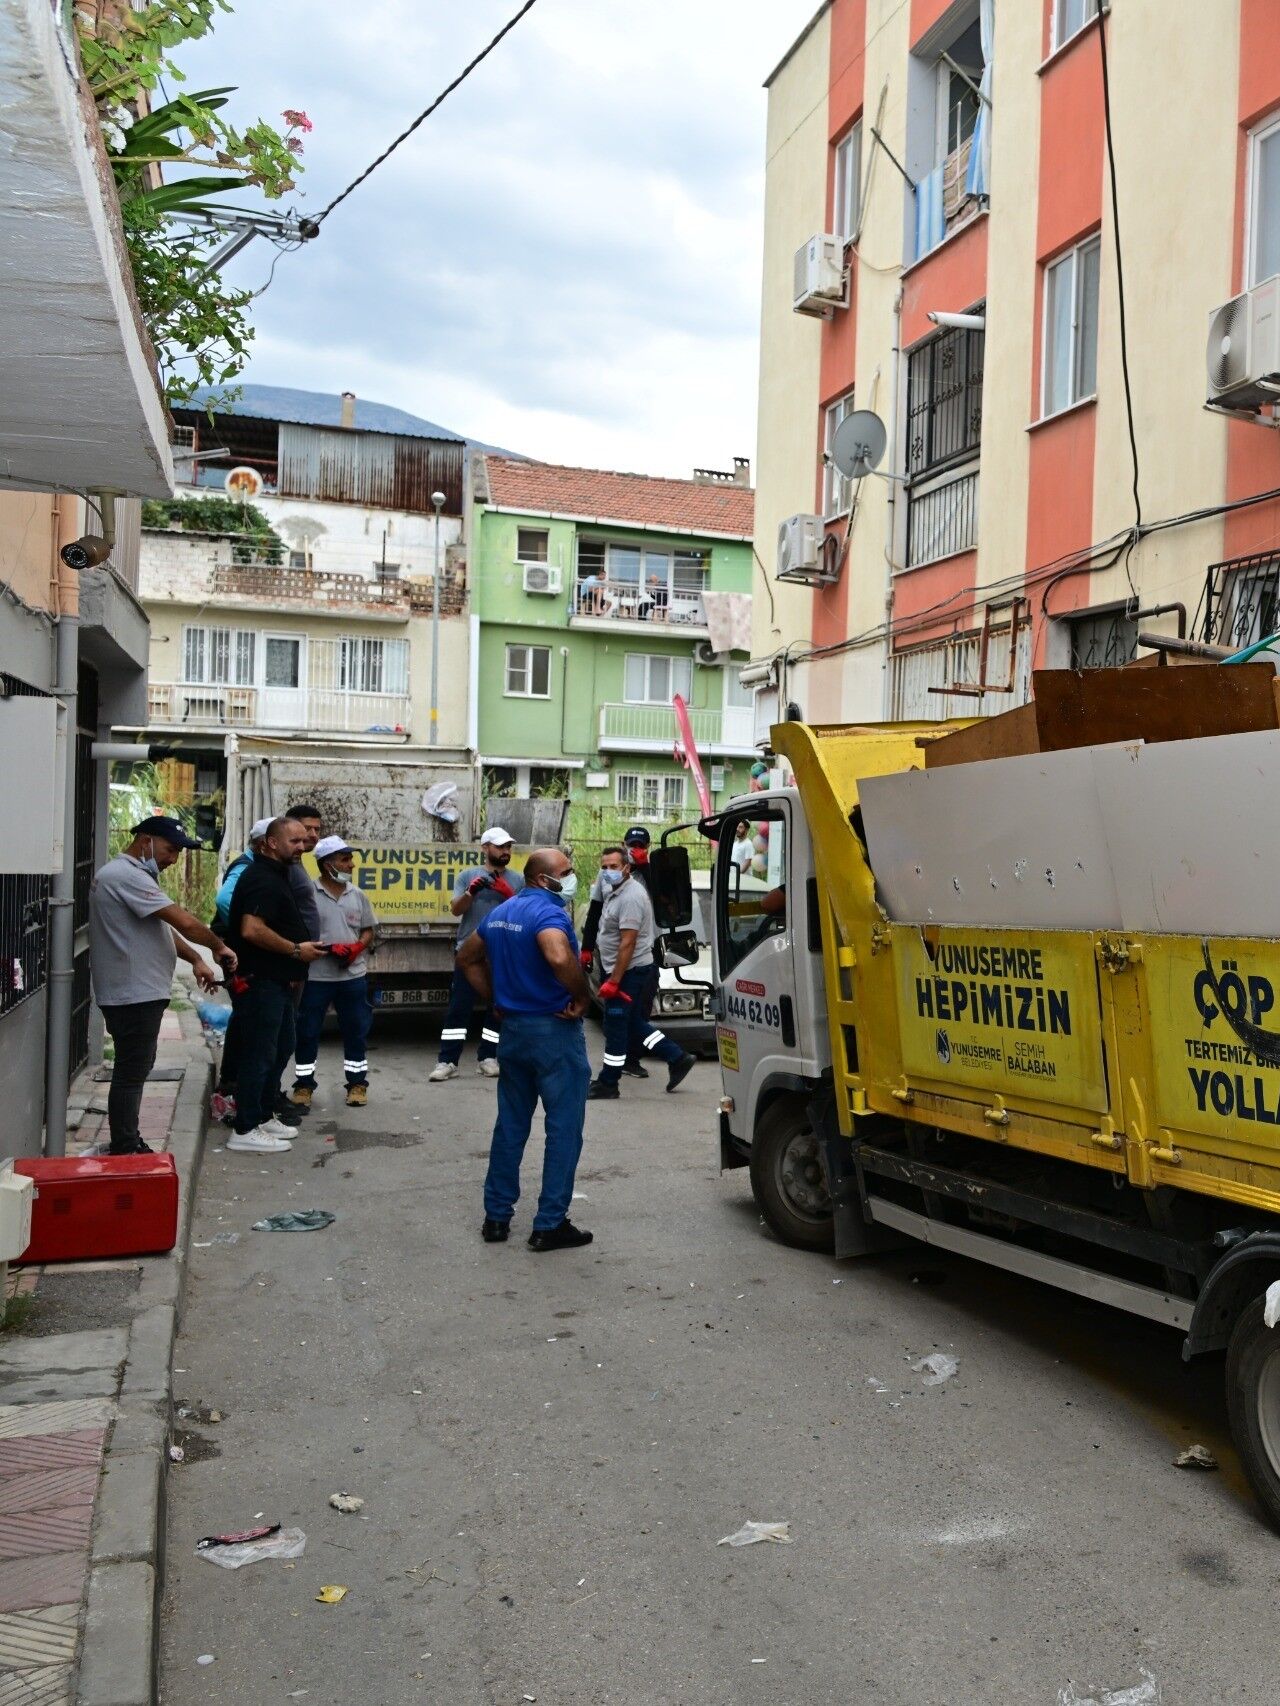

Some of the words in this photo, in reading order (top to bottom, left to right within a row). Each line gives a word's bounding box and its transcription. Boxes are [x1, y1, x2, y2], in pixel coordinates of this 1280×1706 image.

[372, 901, 436, 909] YUNUSEMRE
[934, 944, 1043, 980] YUNUSEMRE
[915, 977, 1072, 1036] HEPİMİZİN
[1193, 960, 1274, 1029] ÇÖP
[727, 995, 747, 1020] 444
[748, 999, 763, 1024] 62
[764, 1003, 780, 1028] 09
[950, 1042, 1002, 1062] YUNUSEMRE
[1014, 1041, 1045, 1060] SEMİH
[1184, 1039, 1252, 1066] TERTEMİZ
[1007, 1055, 1056, 1077] BALABAN
